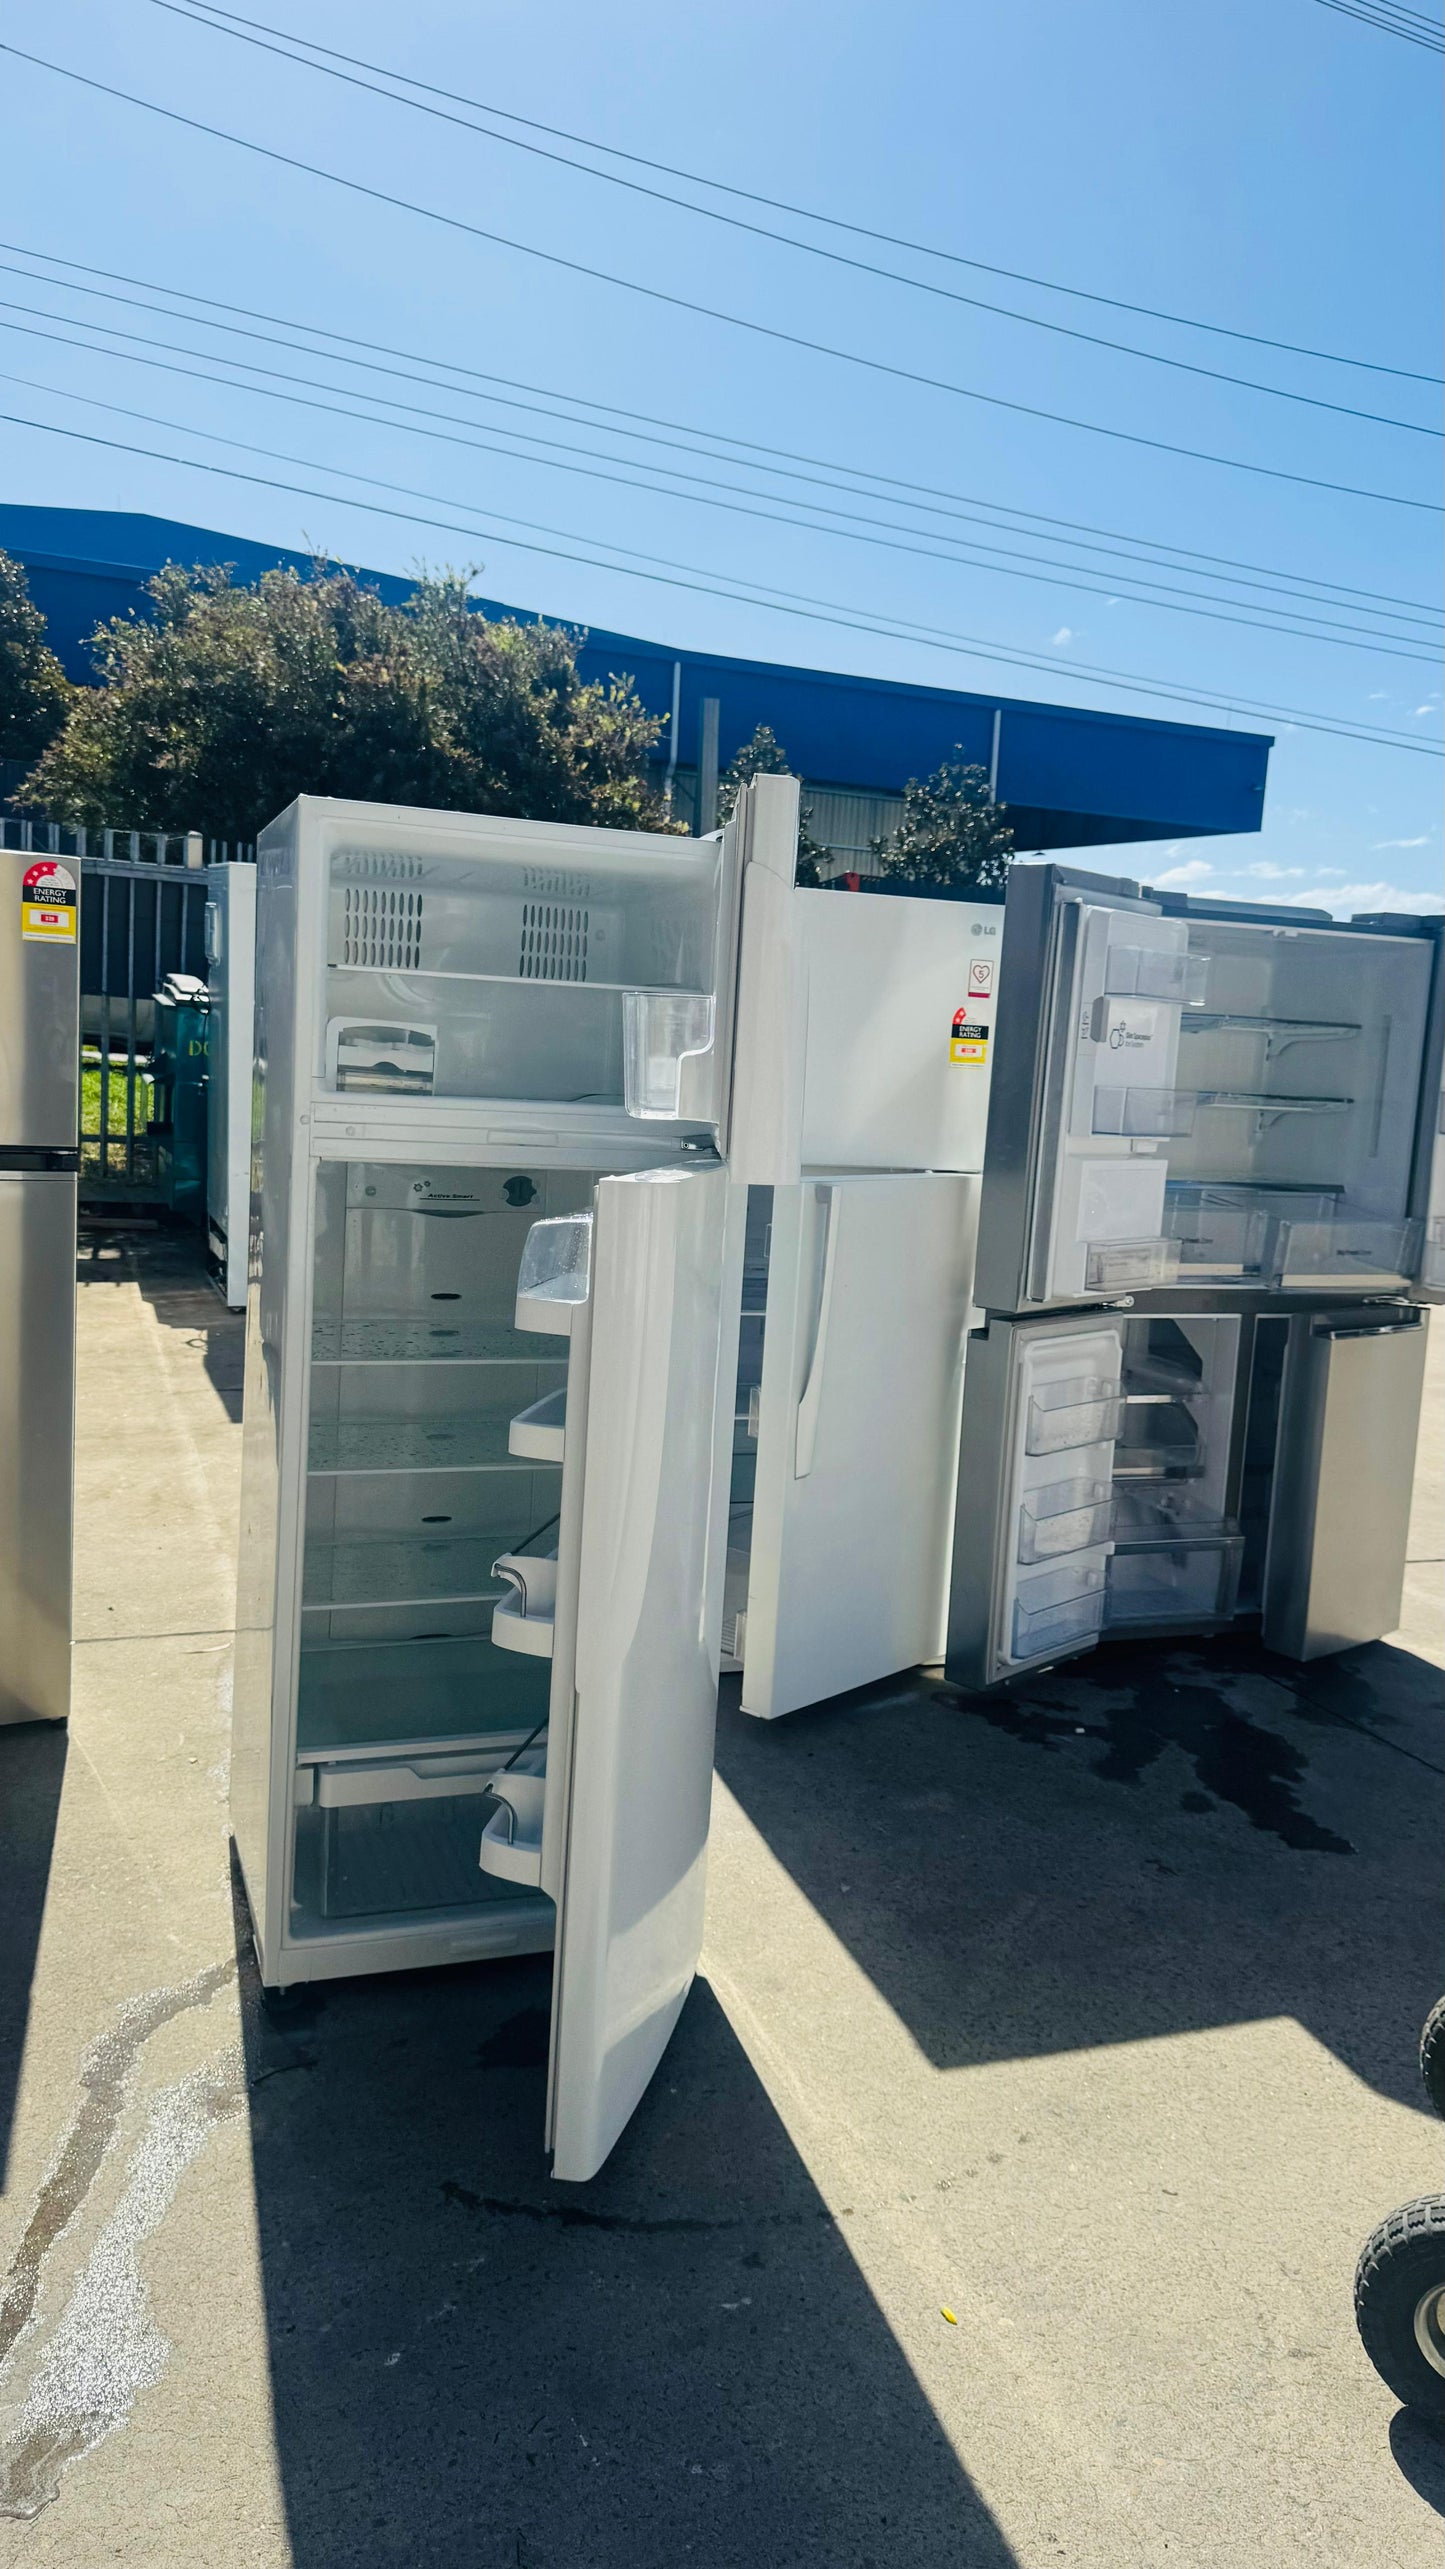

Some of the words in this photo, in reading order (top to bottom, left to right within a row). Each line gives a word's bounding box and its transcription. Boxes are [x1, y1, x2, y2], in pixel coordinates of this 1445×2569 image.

[33, 887, 67, 897] ENERGY
[34, 895, 67, 904] RATING
[984, 926, 996, 936] LG
[979, 969, 985, 979] 5
[959, 1025, 982, 1033] ENERGY
[959, 1031, 982, 1039] RATING
